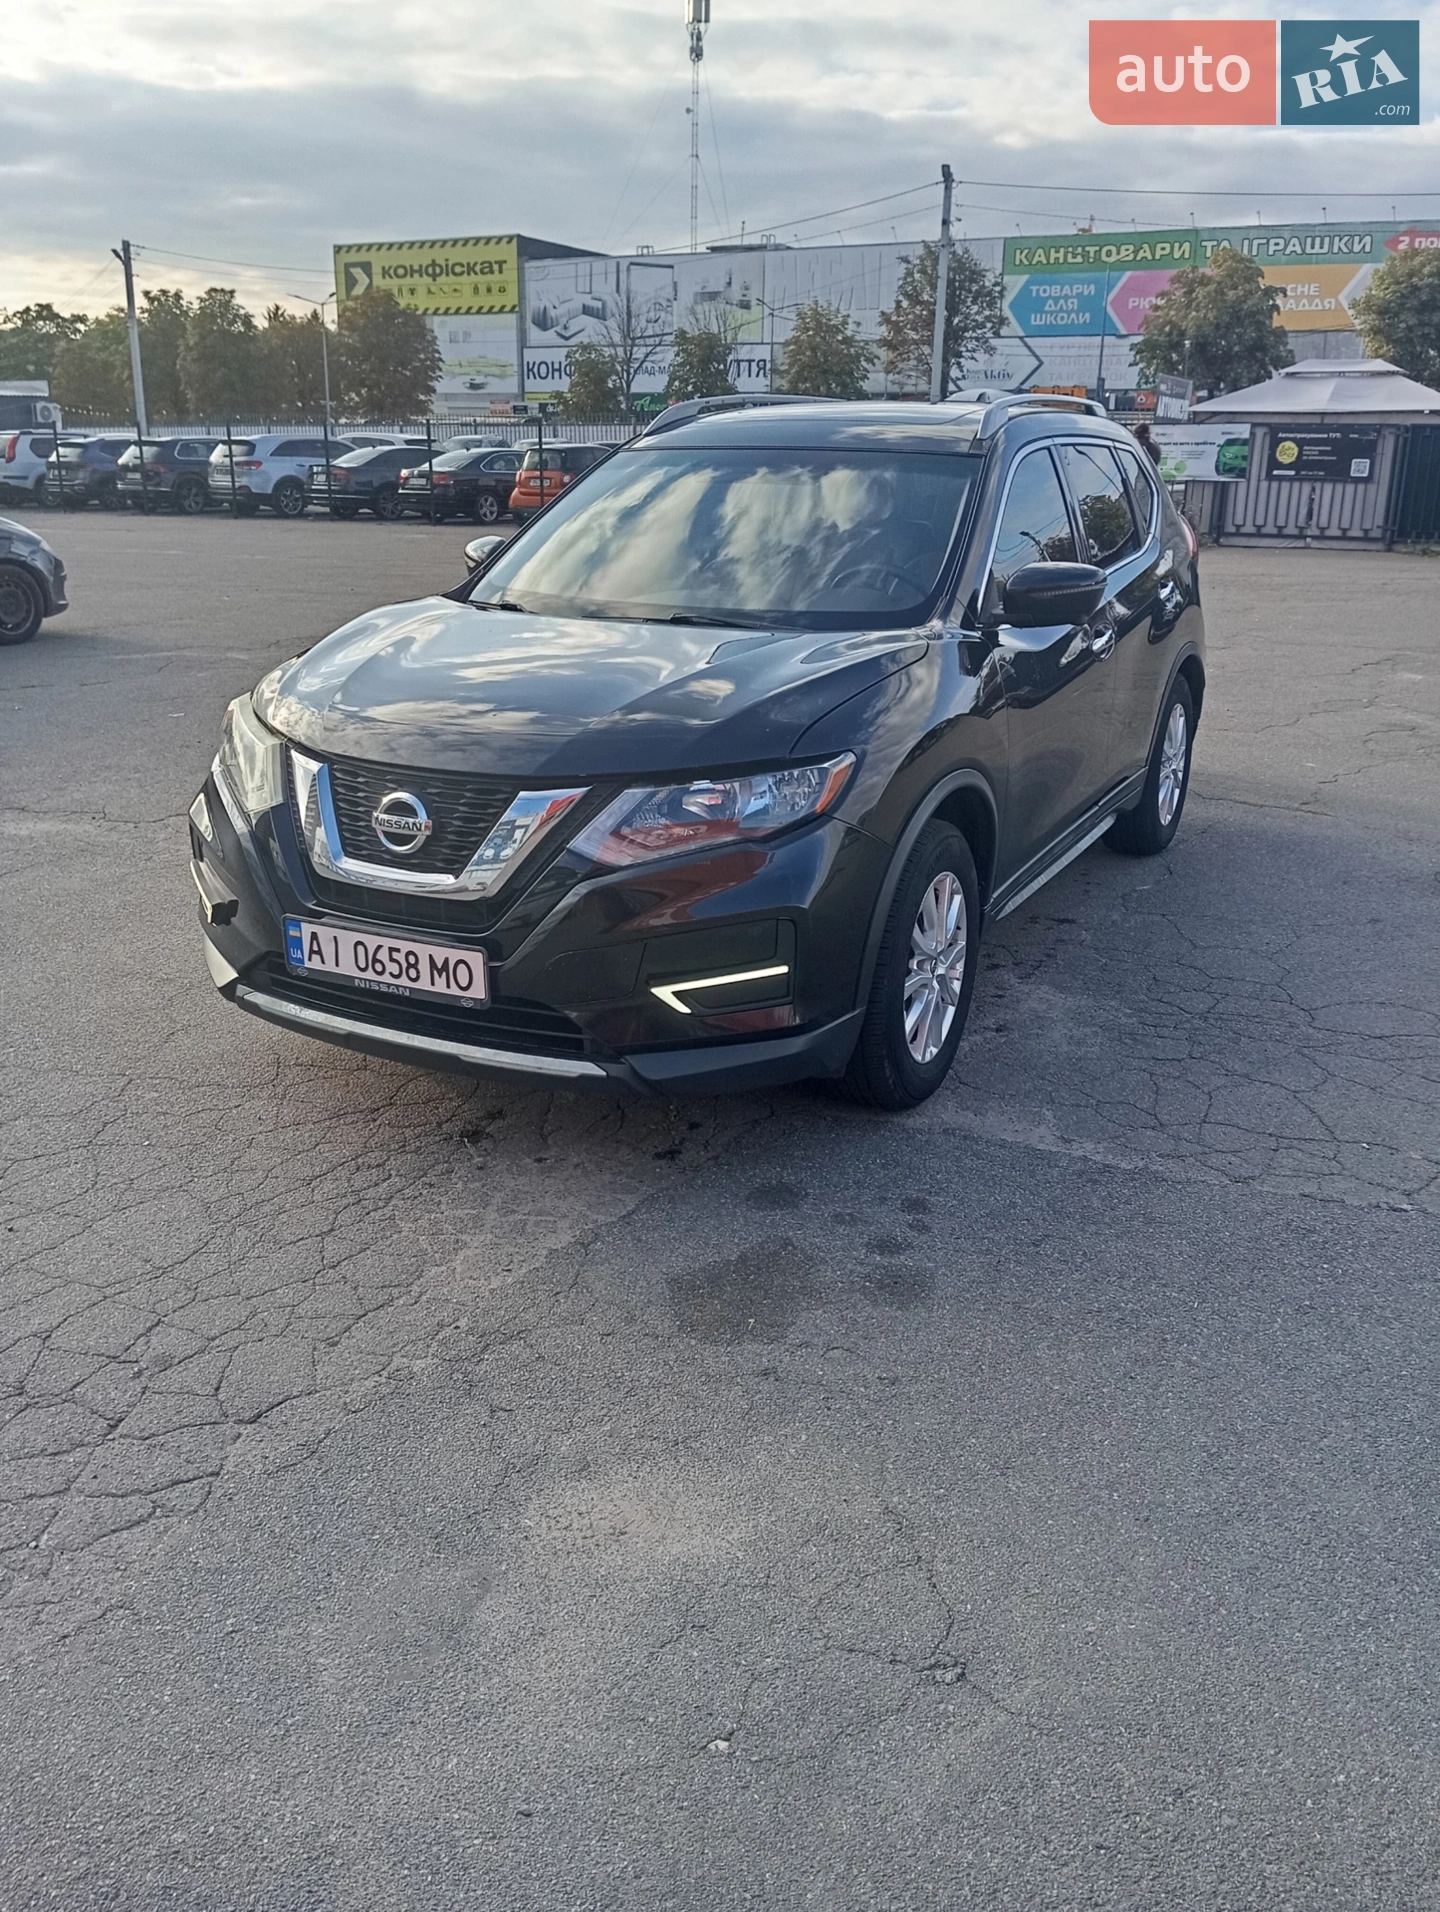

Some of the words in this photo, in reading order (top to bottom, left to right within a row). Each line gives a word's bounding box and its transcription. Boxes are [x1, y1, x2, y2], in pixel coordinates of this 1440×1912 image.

[1014, 241, 1192, 266] КАНЦТОВАРИ
[1242, 234, 1374, 257] ІГРАШКИ
[1397, 236, 1410, 250] 2
[1030, 284, 1096, 297] ТОВАРИ
[1043, 299, 1078, 311] ДЛЯ
[1030, 312, 1091, 326] ШКОЛИ
[374, 816, 422, 832] NISSAN
[291, 947, 303, 960] UA
[308, 931, 340, 968] AI
[353, 939, 421, 983] 0658
[429, 953, 474, 992] MO
[354, 978, 411, 997] NISSAN
